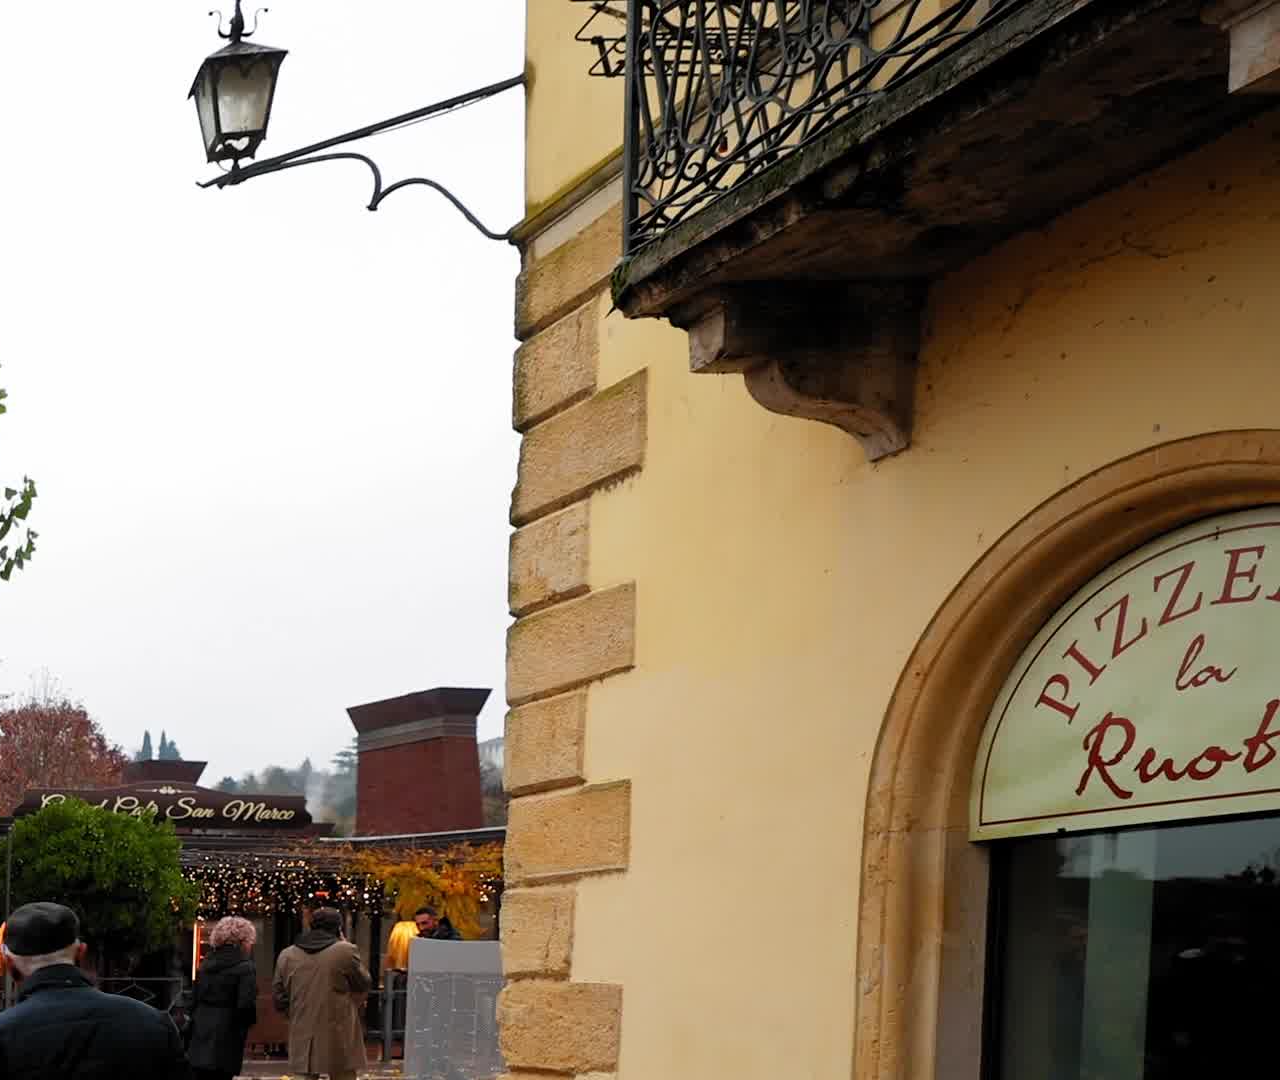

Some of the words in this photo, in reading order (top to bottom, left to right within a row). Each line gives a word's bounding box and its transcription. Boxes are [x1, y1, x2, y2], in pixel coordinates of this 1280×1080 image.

[1175, 633, 1237, 690] la
[166, 797, 215, 820] San
[222, 800, 295, 821] Marco
